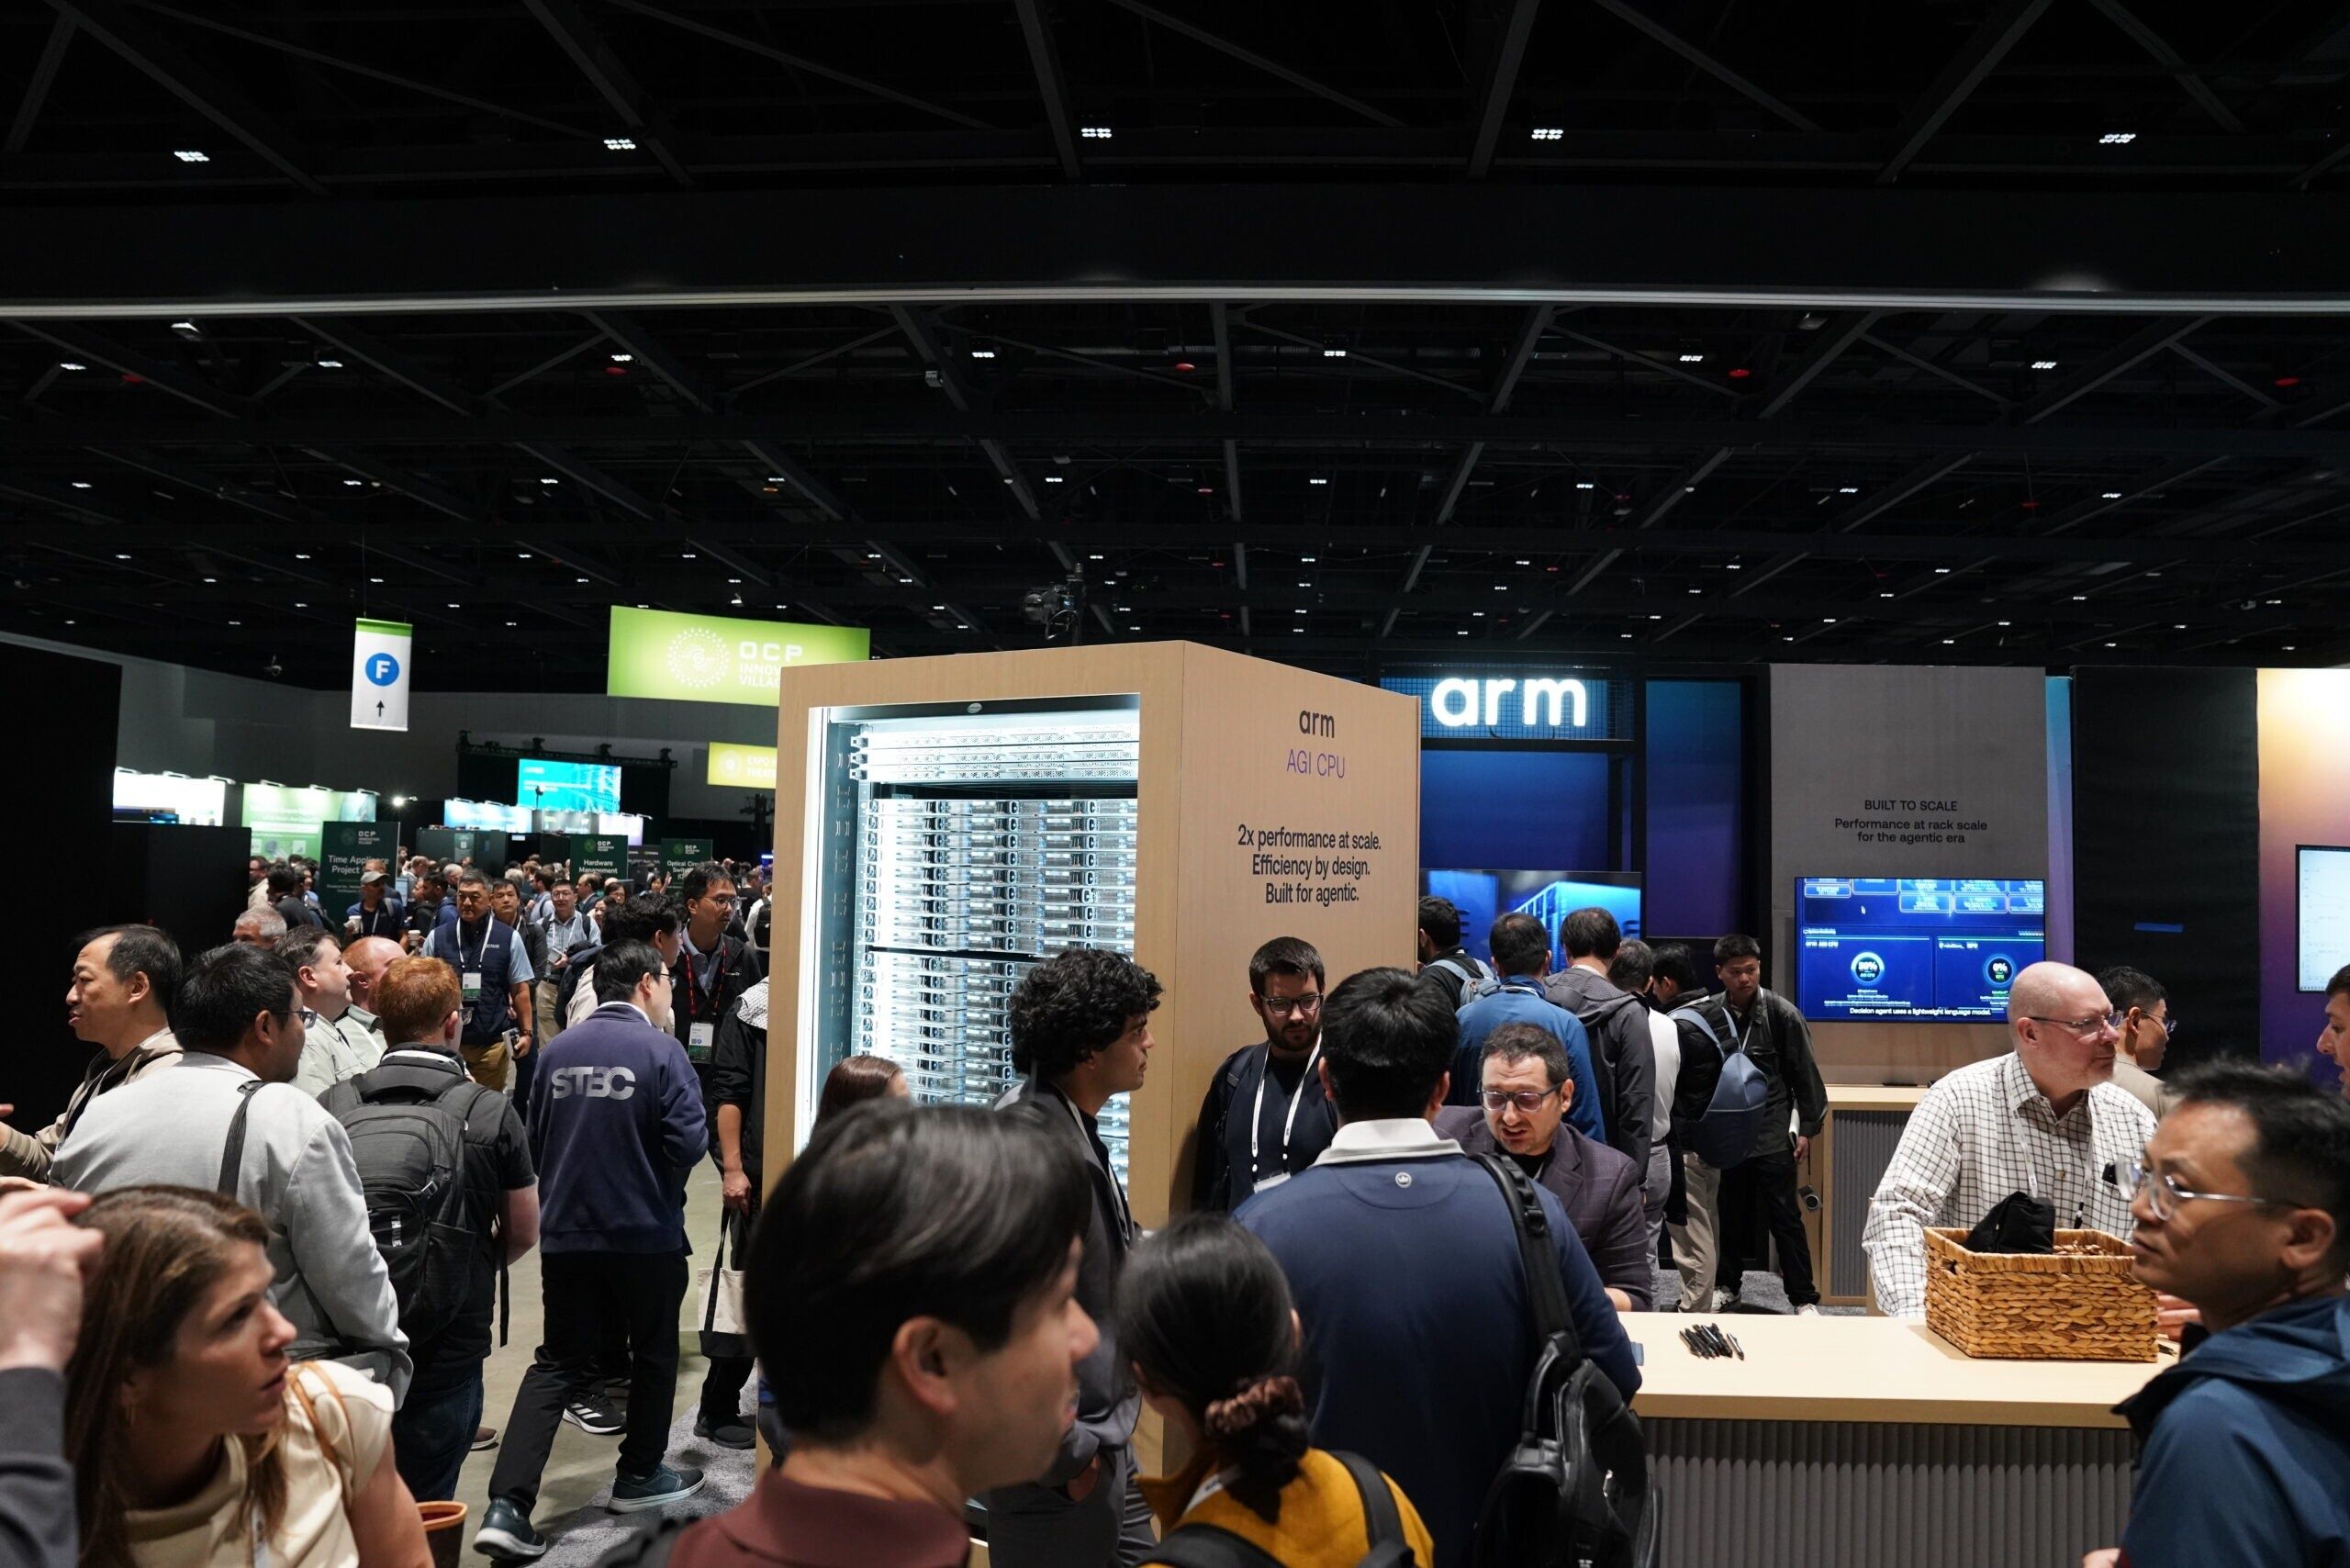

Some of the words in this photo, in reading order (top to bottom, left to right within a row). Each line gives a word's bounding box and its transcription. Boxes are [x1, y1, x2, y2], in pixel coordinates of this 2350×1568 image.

[739, 641, 803, 662] OCP
[375, 660, 391, 679] F
[740, 662, 781, 677] INNOV
[1431, 678, 1586, 727] arm
[1299, 710, 1335, 738] arm
[1286, 748, 1312, 775] AGI
[1316, 753, 1346, 778] CPU
[1864, 800, 1897, 811] BUILT
[1899, 800, 1917, 811] TO
[1919, 801, 1958, 812] SCALE
[1835, 818, 1910, 830] Performance
[1914, 820, 1925, 830] at
[1928, 820, 1953, 830] rack
[1956, 820, 1987, 831] scale
[1237, 823, 1255, 846] 2x
[1258, 826, 1337, 851] performance
[1338, 831, 1349, 849] at
[1351, 831, 1382, 850] scale.
[1857, 831, 1874, 842] for
[1876, 832, 1897, 843] the
[1899, 832, 1943, 845] agentic
[1946, 834, 1965, 843] era
[328, 855, 348, 864] Time
[1252, 854, 1313, 880] Efficiency
[1315, 855, 1329, 880] by
[1332, 856, 1371, 880] design.
[331, 866, 360, 876] Project
[1265, 882, 1293, 903] Built
[1296, 882, 1314, 903] for
[1315, 882, 1360, 907] agentic.
[1912, 1008, 1944, 1016] lightweight
[1944, 1008, 1971, 1016] language
[551, 1066, 636, 1101] STBC
[391, 1214, 402, 1248] THULE
